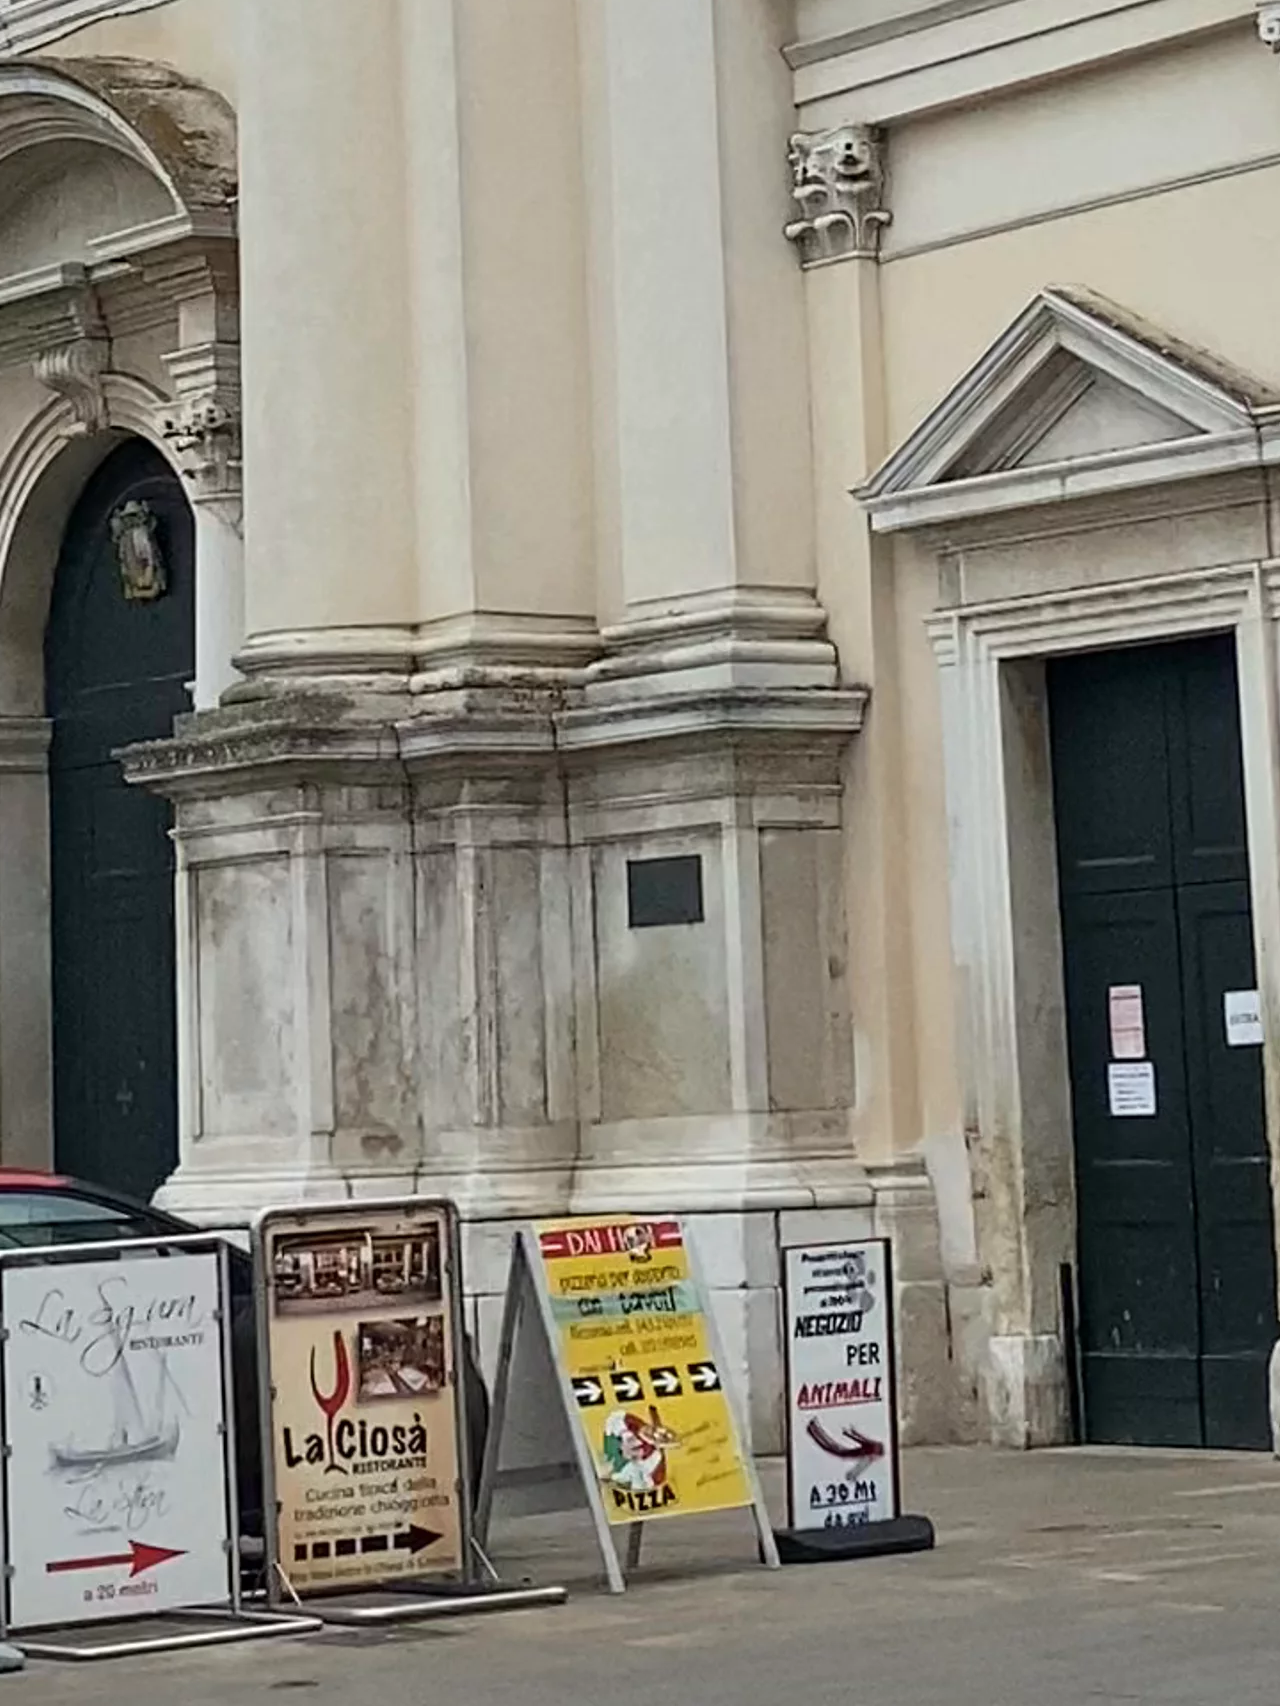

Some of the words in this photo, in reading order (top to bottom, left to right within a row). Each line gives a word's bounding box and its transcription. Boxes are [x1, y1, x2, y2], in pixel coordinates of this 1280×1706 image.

[794, 1310, 864, 1339] NEGOZIO
[846, 1342, 881, 1367] PER
[797, 1376, 882, 1407] ANIMALI
[282, 1426, 325, 1469] La
[335, 1412, 428, 1460] Ciosà
[351, 1456, 428, 1476] RISTORANTE
[612, 1483, 676, 1512] PIZZA
